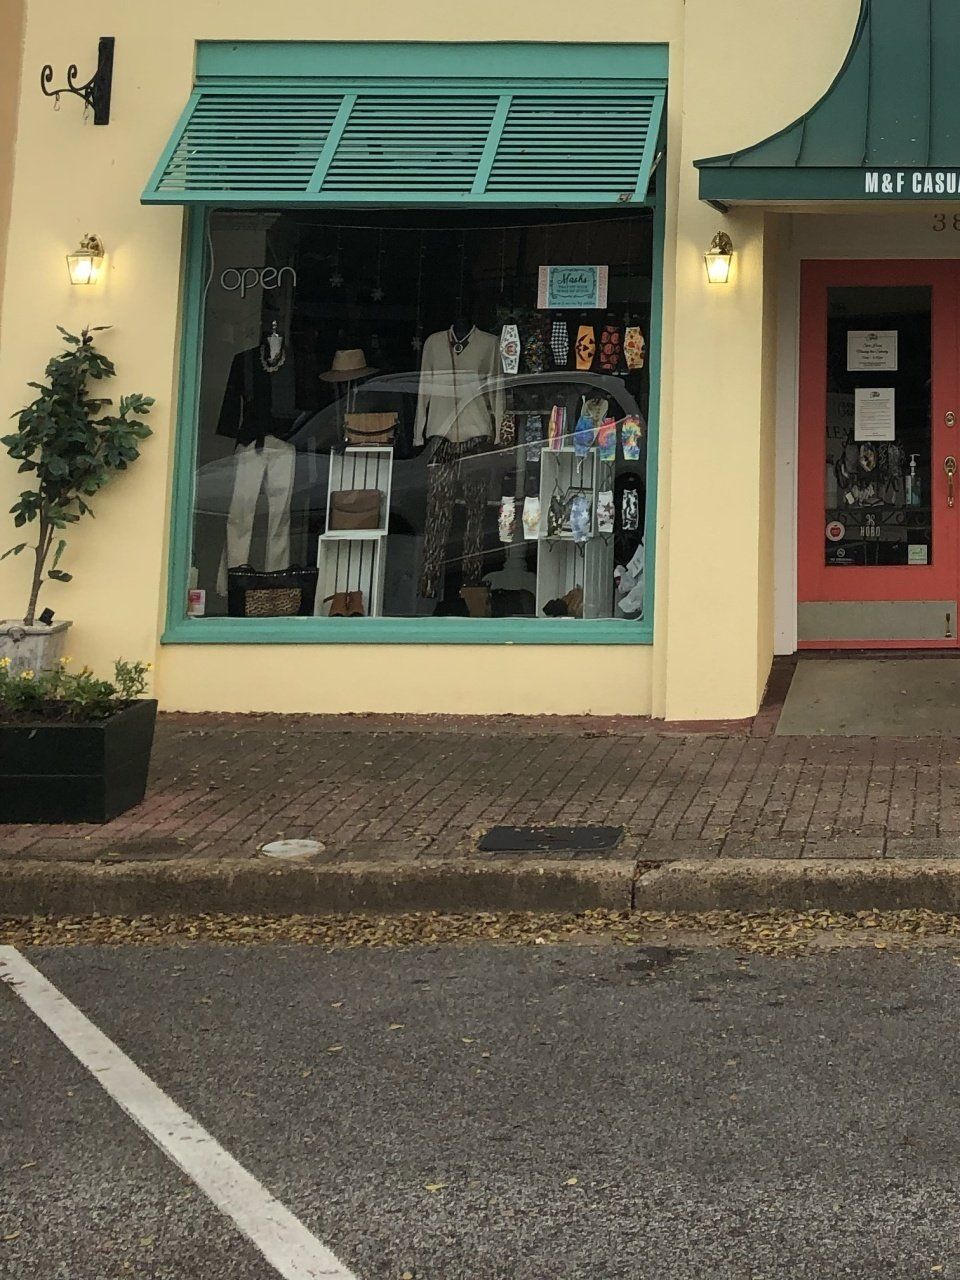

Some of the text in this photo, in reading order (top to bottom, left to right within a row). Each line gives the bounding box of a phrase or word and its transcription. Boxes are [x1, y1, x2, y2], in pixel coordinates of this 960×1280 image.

[865, 172, 905, 193] M&F
[220, 266, 297, 298] open
[860, 526, 880, 537] HOBO
